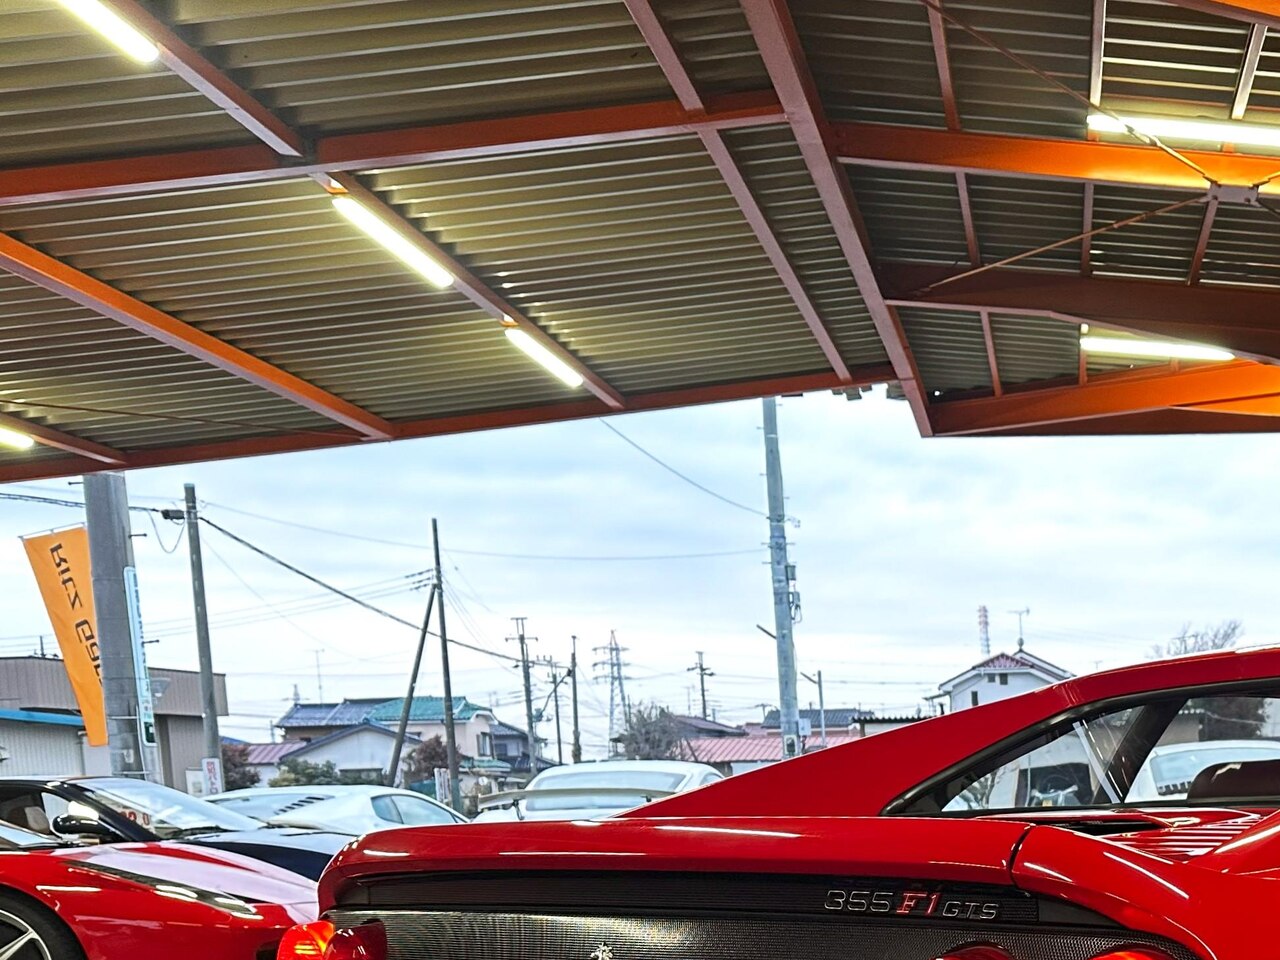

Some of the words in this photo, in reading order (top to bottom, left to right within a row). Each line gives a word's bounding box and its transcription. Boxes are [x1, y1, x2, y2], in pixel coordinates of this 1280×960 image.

[824, 889, 893, 913] 355
[895, 891, 942, 917] F1
[942, 901, 1000, 920] GTS
